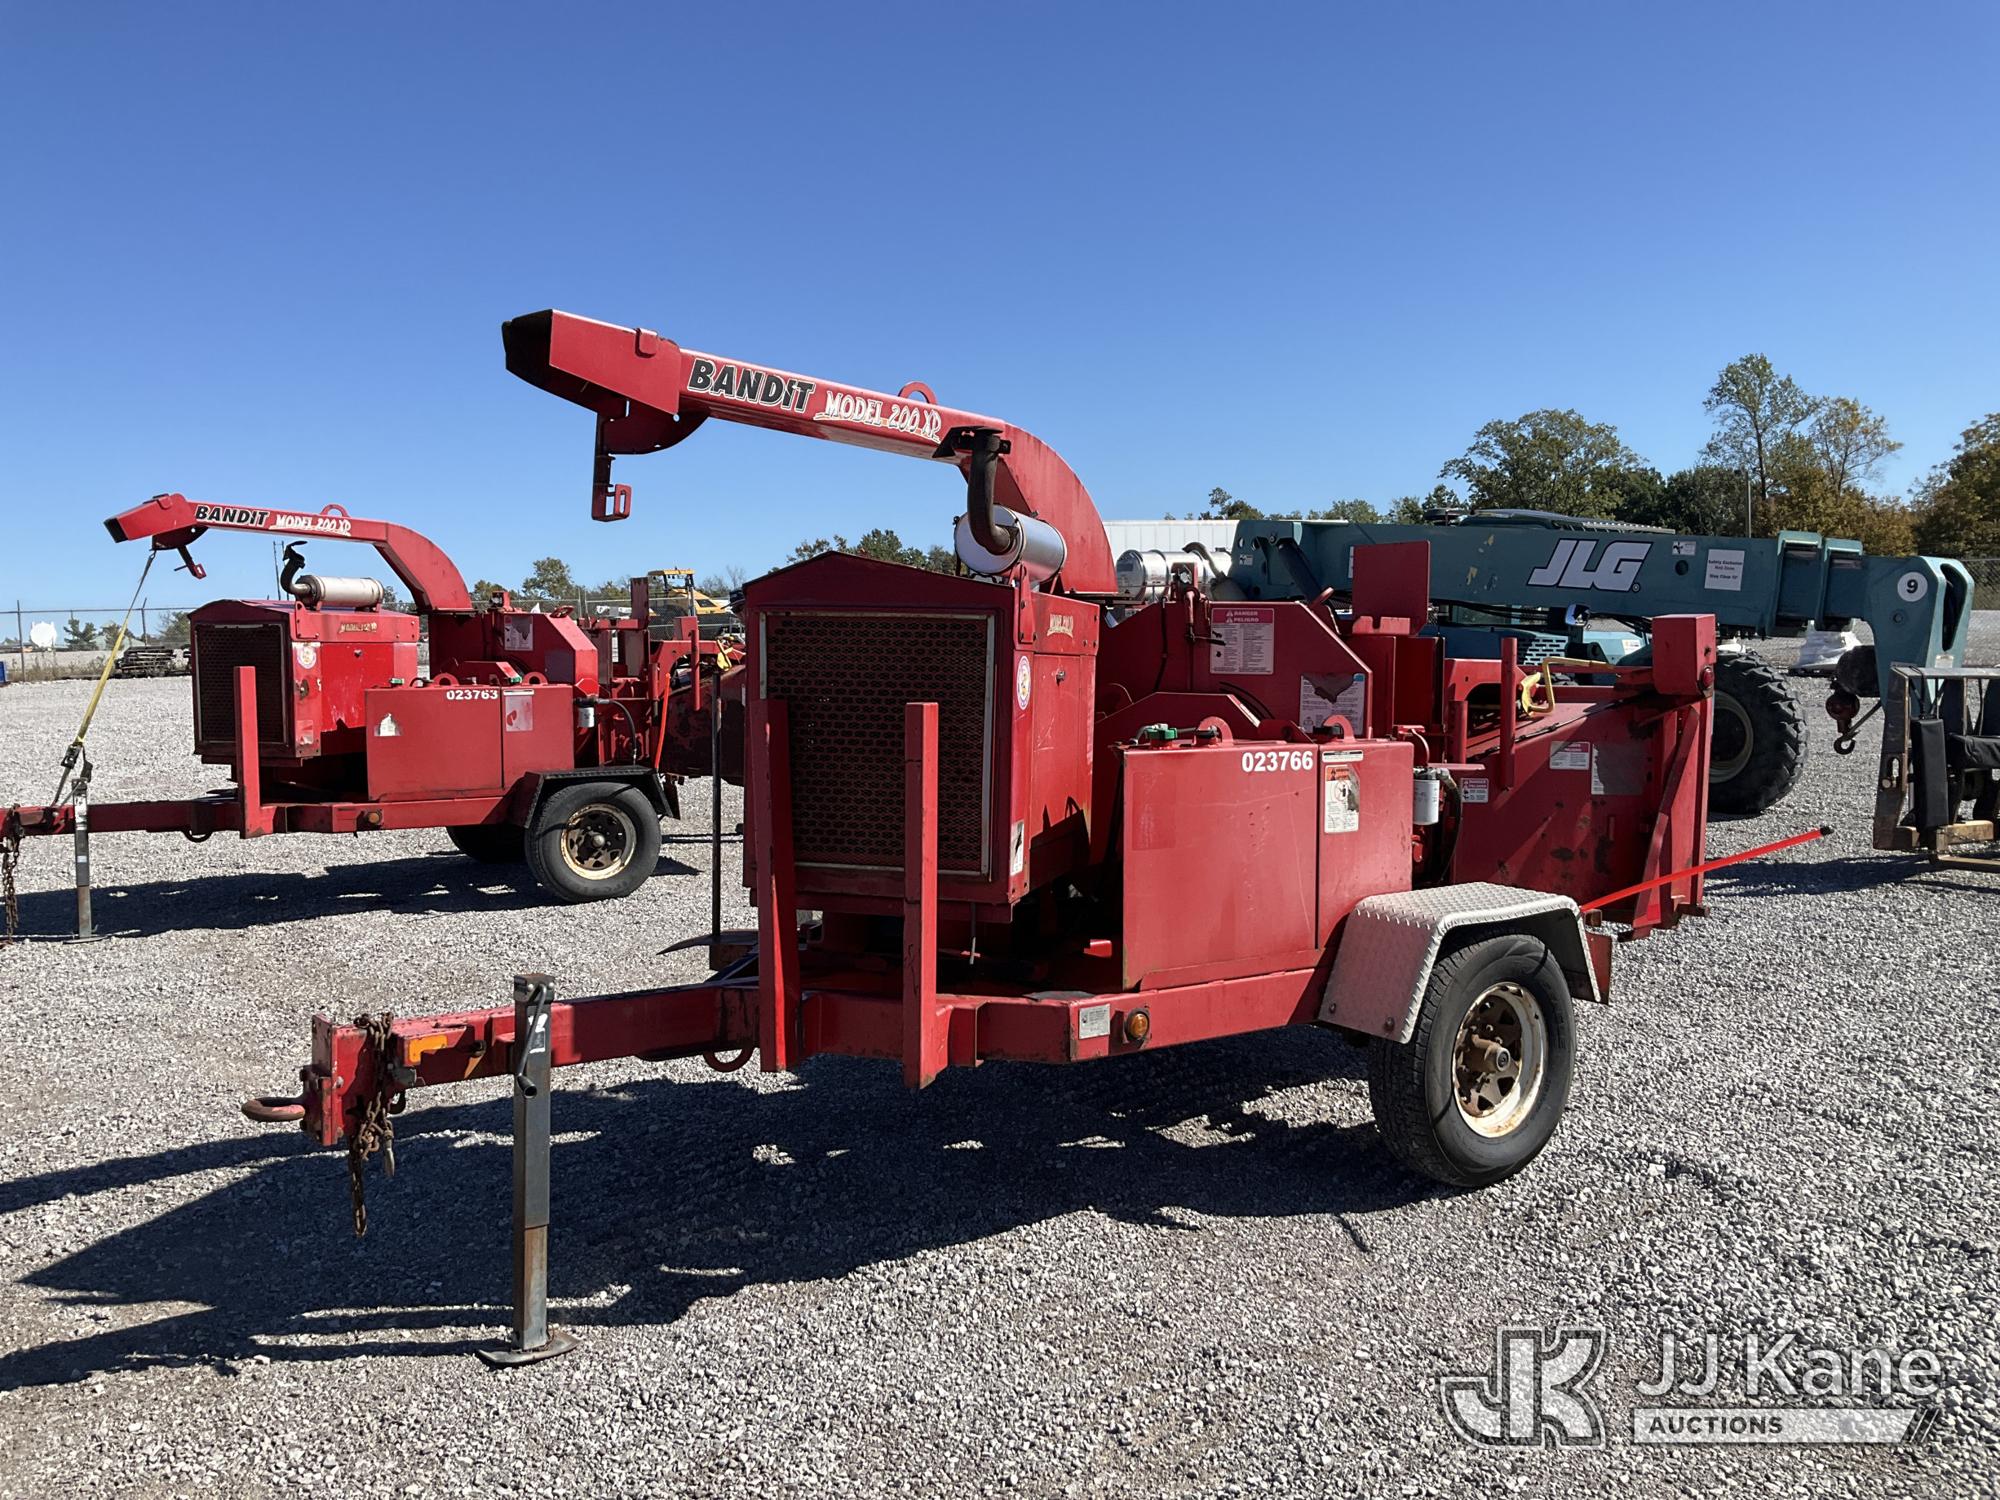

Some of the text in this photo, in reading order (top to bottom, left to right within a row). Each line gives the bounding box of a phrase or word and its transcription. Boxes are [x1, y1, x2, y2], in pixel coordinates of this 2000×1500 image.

[687, 357, 815, 413] BANDIT
[825, 391, 883, 426] MODEL
[888, 404, 920, 434] 200
[195, 505, 270, 528] BANDIT
[275, 514, 314, 528] MODEL
[315, 517, 337, 532] 200
[1527, 538, 1653, 592] JLG
[1906, 579, 1918, 593] 9
[446, 689, 499, 700] 023763
[1241, 751, 1314, 772] 023766
